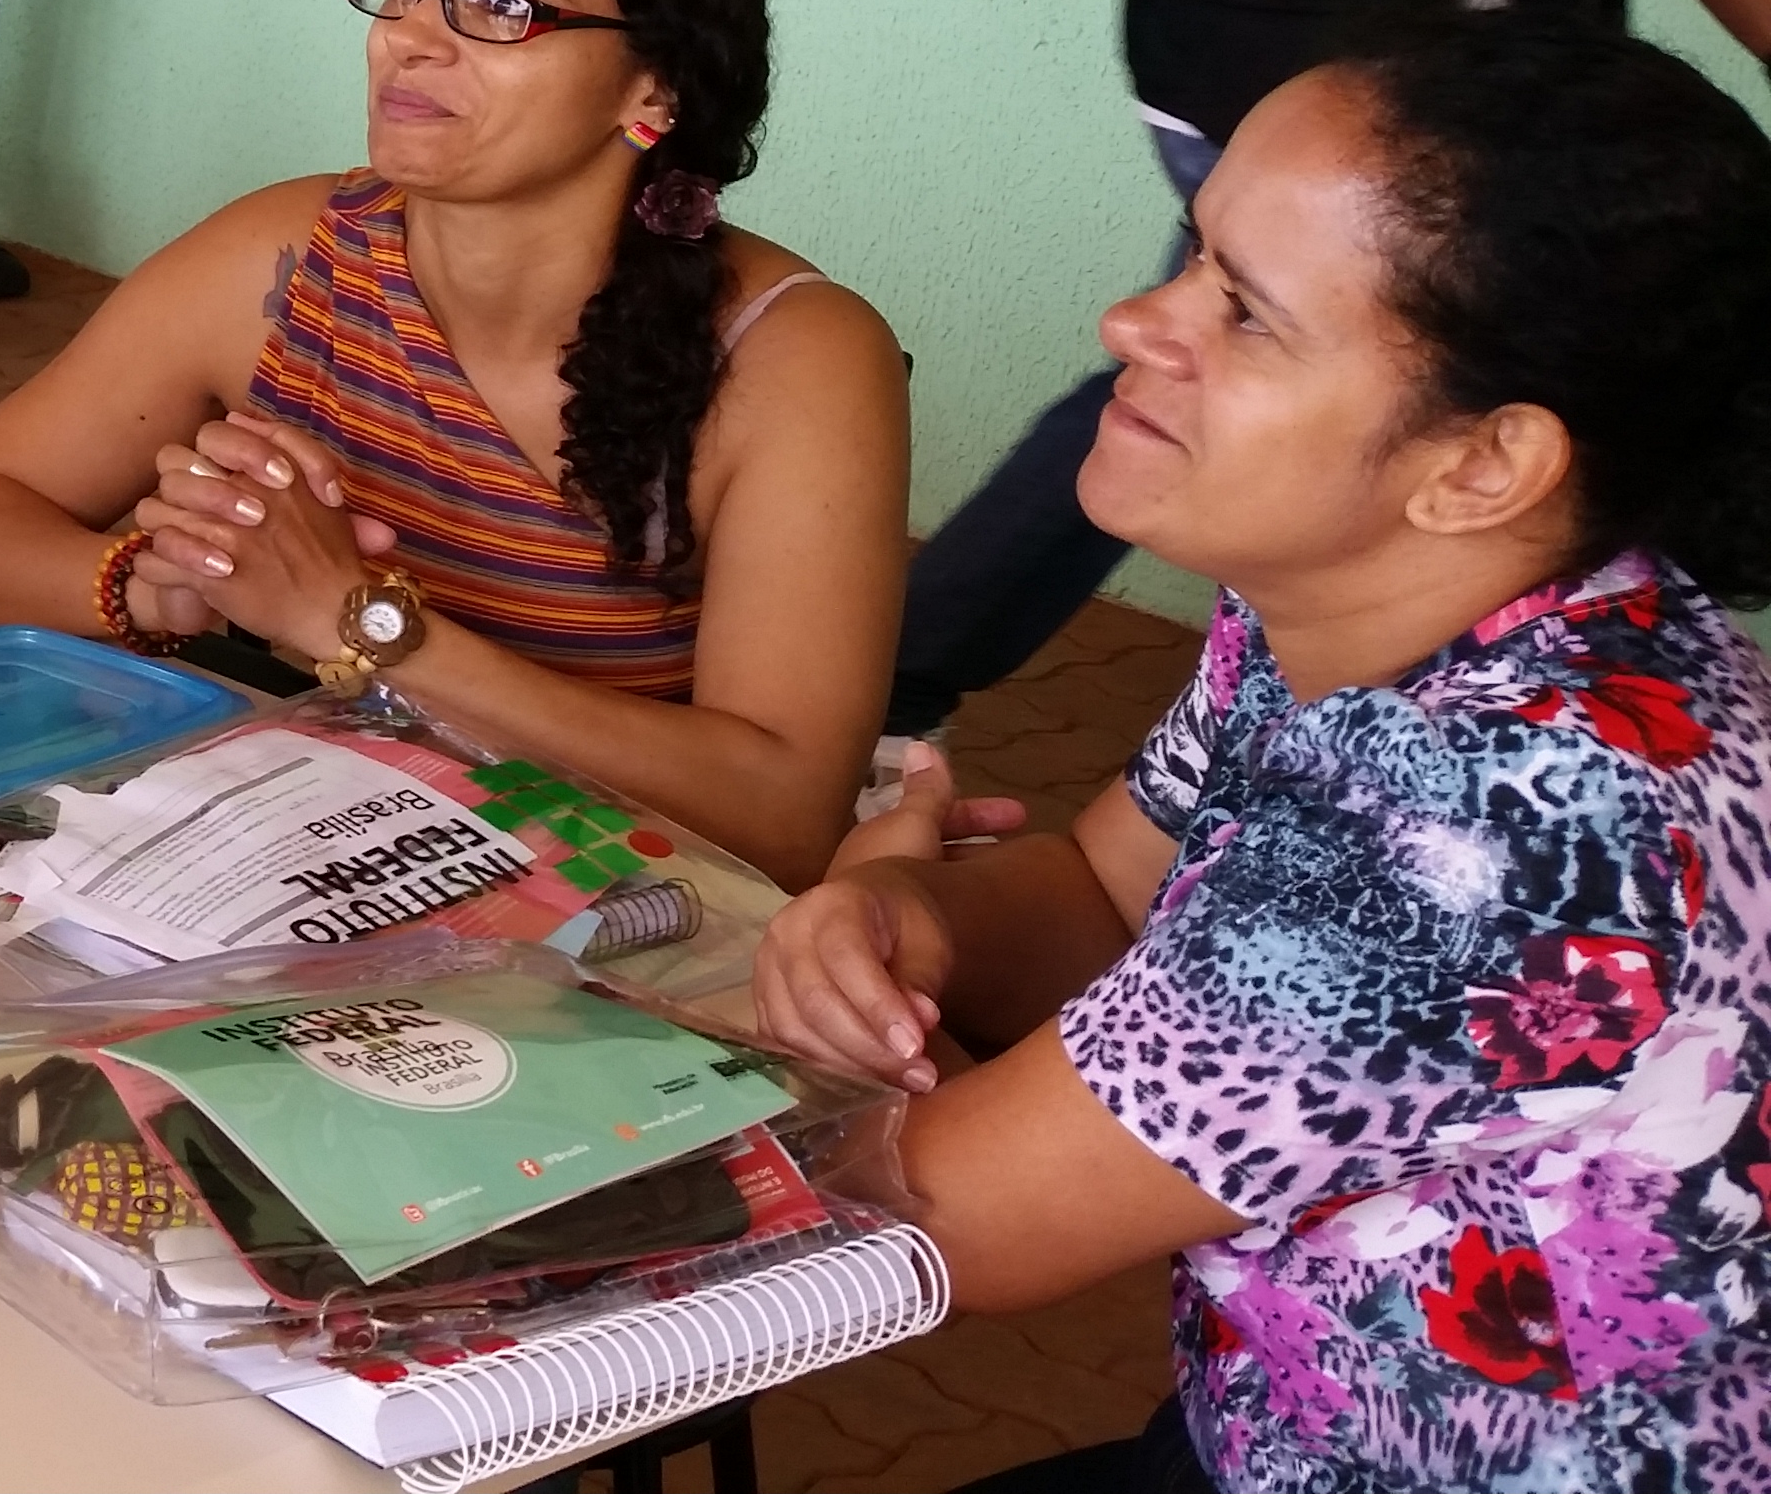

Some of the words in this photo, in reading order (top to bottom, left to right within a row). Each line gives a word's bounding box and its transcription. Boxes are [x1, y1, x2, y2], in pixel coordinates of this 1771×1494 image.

[303, 788, 436, 840] Brasília
[279, 817, 491, 900] FEDERAL
[289, 846, 534, 944] INSTITUTO
[200, 997, 425, 1043] INSTITUTO
[250, 1014, 442, 1053] FEDERAL
[358, 1038, 473, 1077] INSTITUTO
[384, 1052, 484, 1087] FEDERAL
